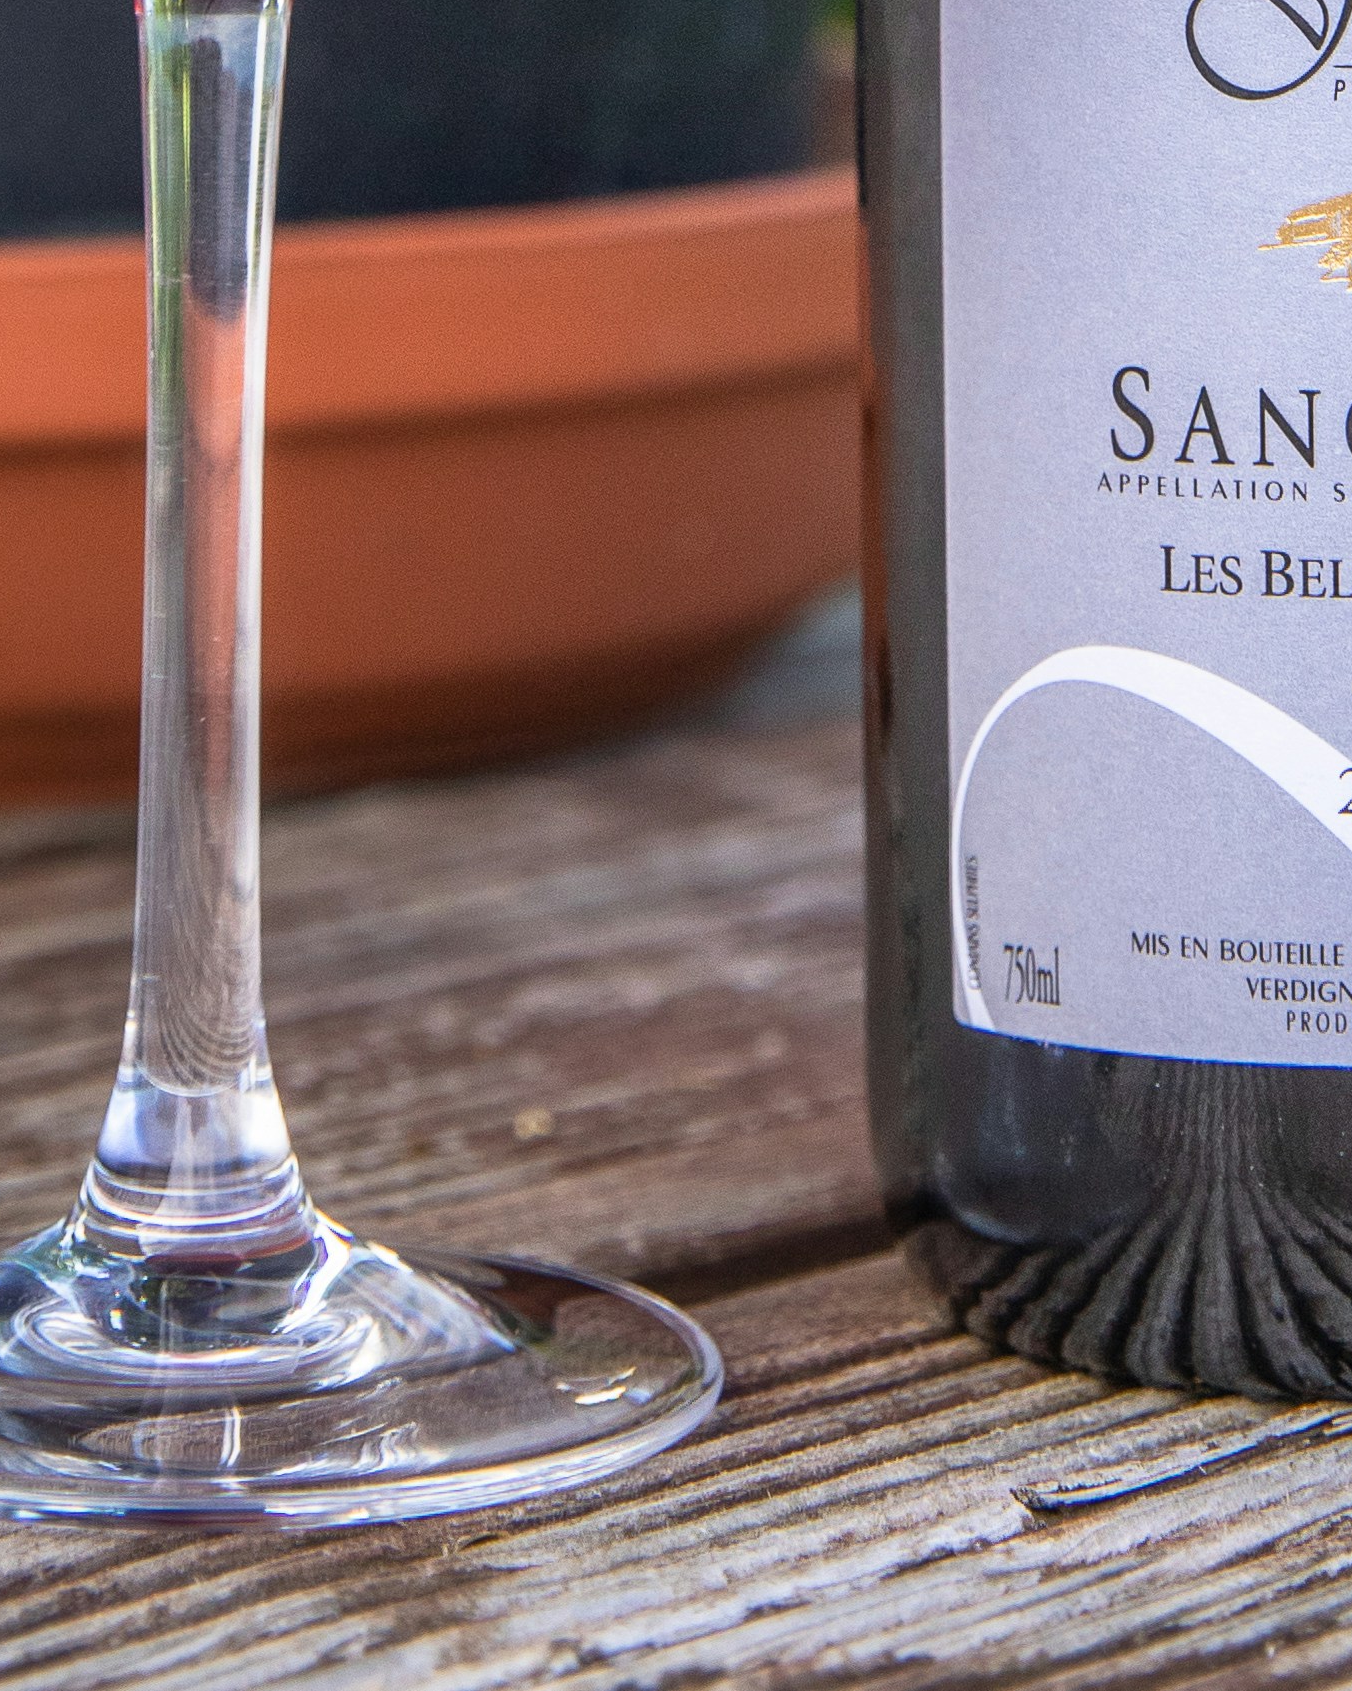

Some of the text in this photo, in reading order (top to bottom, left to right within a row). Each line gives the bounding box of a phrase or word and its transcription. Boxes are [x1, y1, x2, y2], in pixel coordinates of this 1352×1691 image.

[1097, 471, 1309, 502] APPELLATION
[1159, 544, 1244, 596] LES
[1131, 931, 1170, 956] MIS
[1180, 935, 1208, 960] EN
[1220, 938, 1345, 967] BOUTEILLE
[1003, 943, 1061, 1007] 750ml
